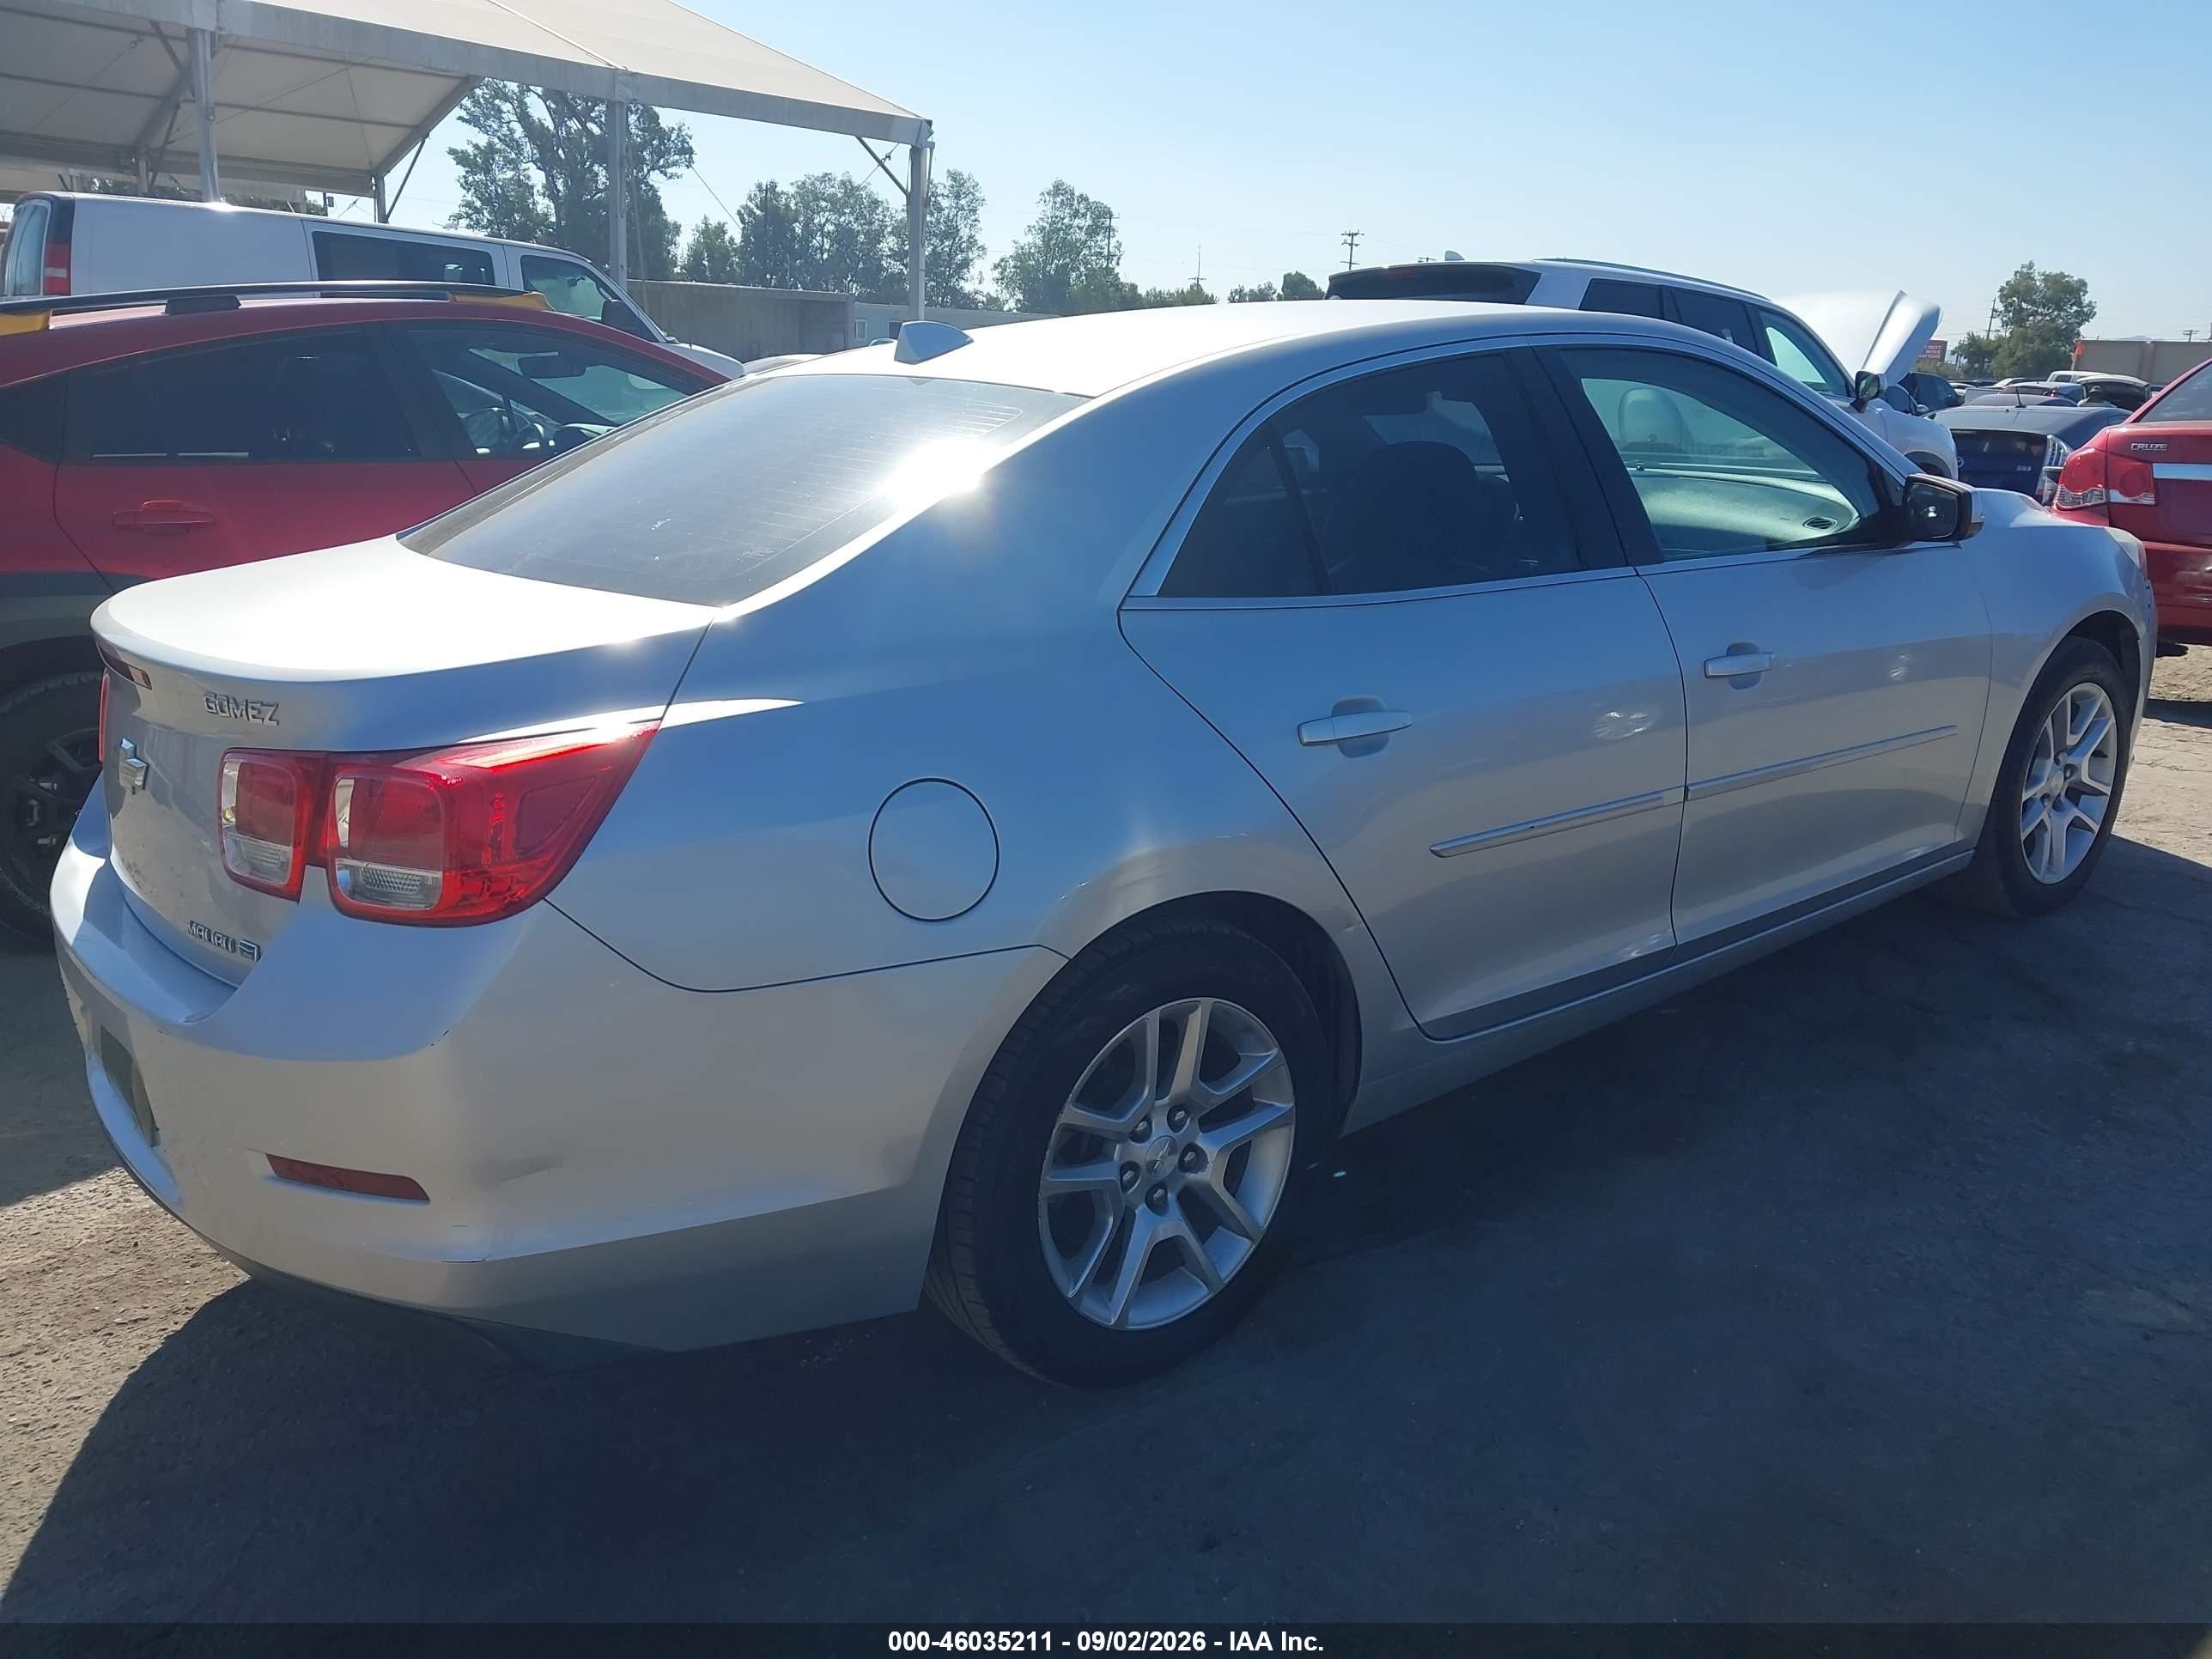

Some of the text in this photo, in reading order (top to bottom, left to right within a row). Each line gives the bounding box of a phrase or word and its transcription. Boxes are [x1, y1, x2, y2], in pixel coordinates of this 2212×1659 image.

[2130, 442, 2168, 451] CRUZE
[204, 692, 279, 726] GOMEZ
[186, 921, 236, 953] MALIBU
